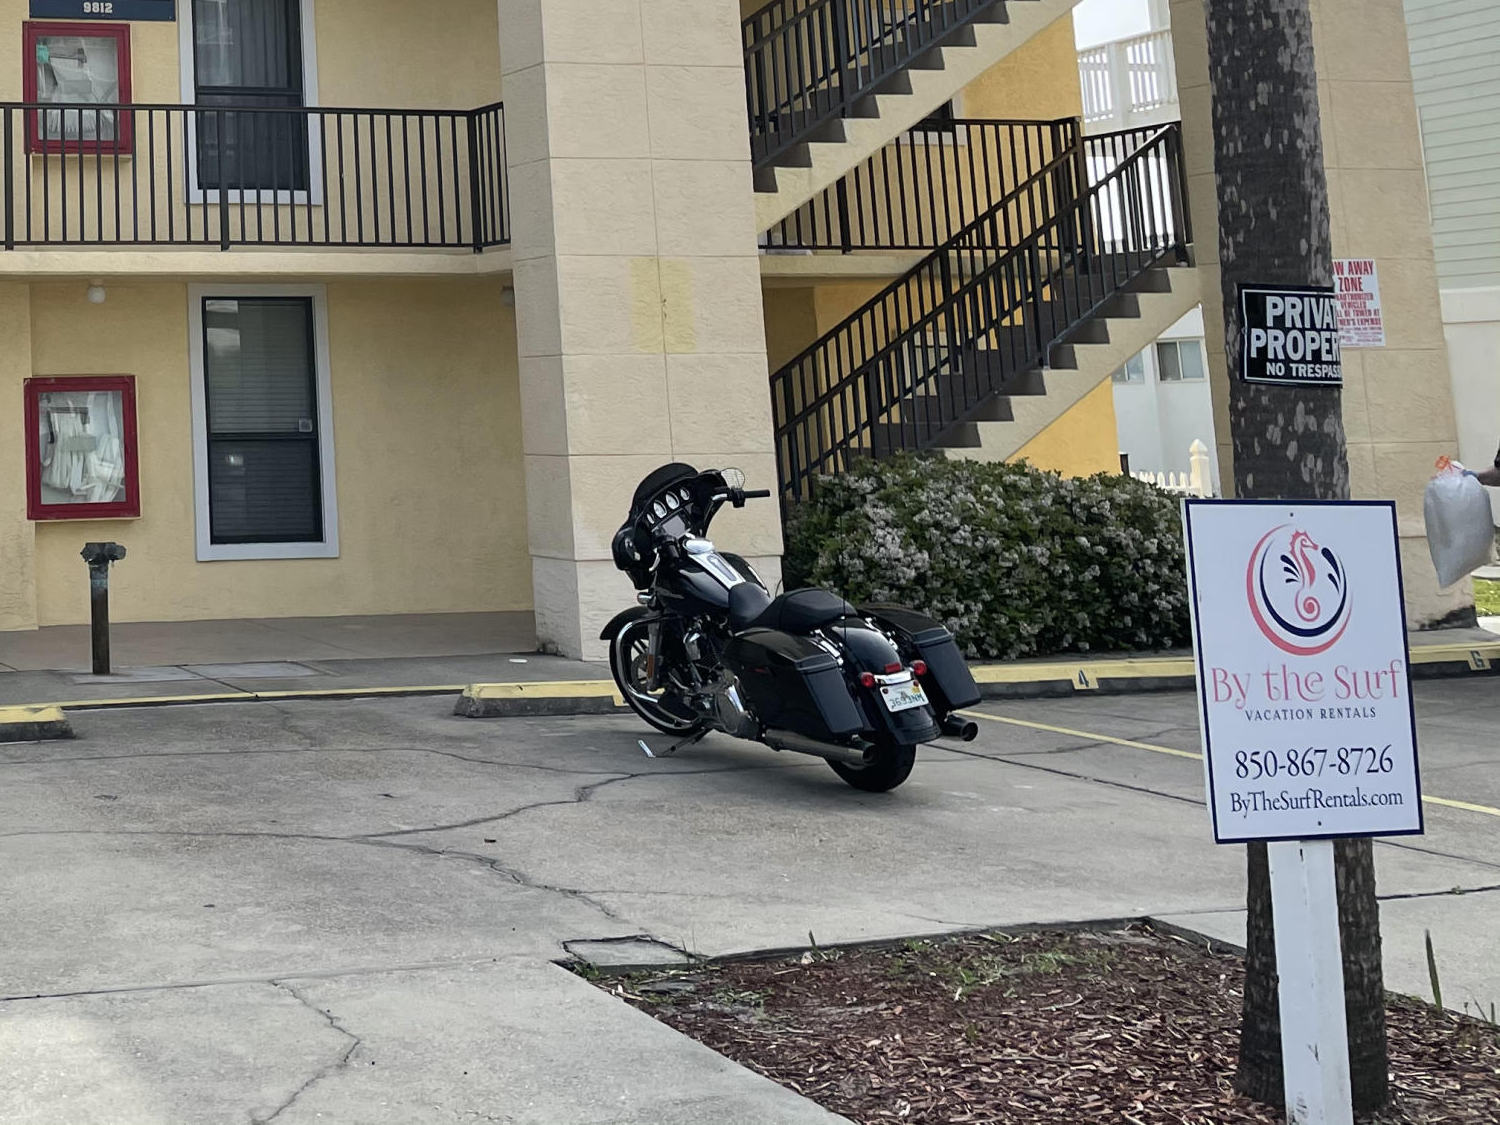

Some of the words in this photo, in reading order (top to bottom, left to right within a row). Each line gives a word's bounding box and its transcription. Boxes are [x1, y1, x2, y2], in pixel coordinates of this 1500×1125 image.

[83, 2, 113, 13] 9812
[1348, 261, 1374, 276] AWAY
[1338, 277, 1363, 292] ZONE
[1266, 362, 1285, 376] NO
[1078, 669, 1090, 687] 4
[1211, 667, 1251, 709] By
[1262, 663, 1325, 702] the
[1334, 659, 1402, 700] Surf
[1245, 708, 1313, 721] VACATION
[1320, 707, 1376, 719] RENTALS
[1235, 744, 1394, 780] 850-867-8726
[1230, 787, 1404, 818] ByTheSurfRentals.com
